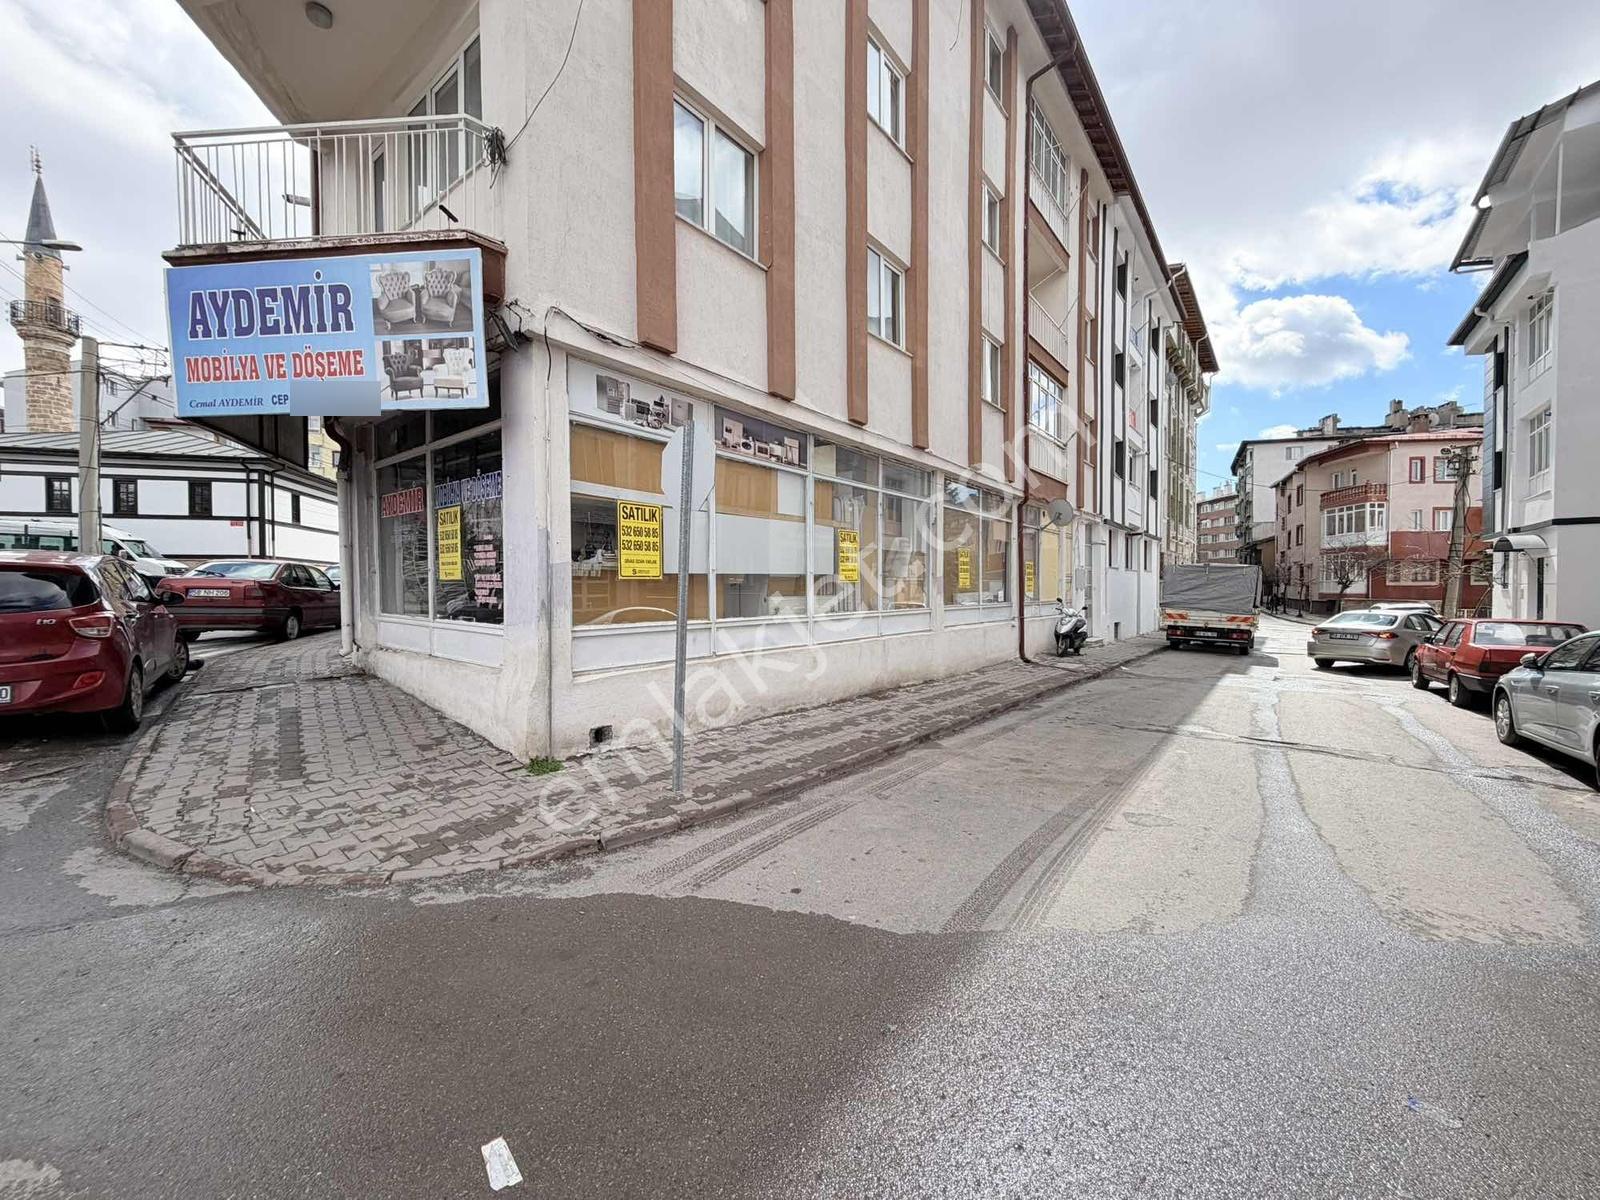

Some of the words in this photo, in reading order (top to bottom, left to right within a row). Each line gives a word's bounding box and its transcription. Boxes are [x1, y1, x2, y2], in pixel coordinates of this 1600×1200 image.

[188, 270, 355, 340] AYDEMİR
[185, 348, 260, 384] MOBİLYA
[263, 354, 286, 378] VE
[292, 345, 365, 381] DÖŞEME
[189, 399, 216, 408] Cemal
[218, 395, 263, 407] AYDEMİR
[271, 394, 289, 406] CEP
[622, 505, 657, 522] SATILIK
[621, 525, 633, 537] 532
[621, 539, 633, 551] 532
